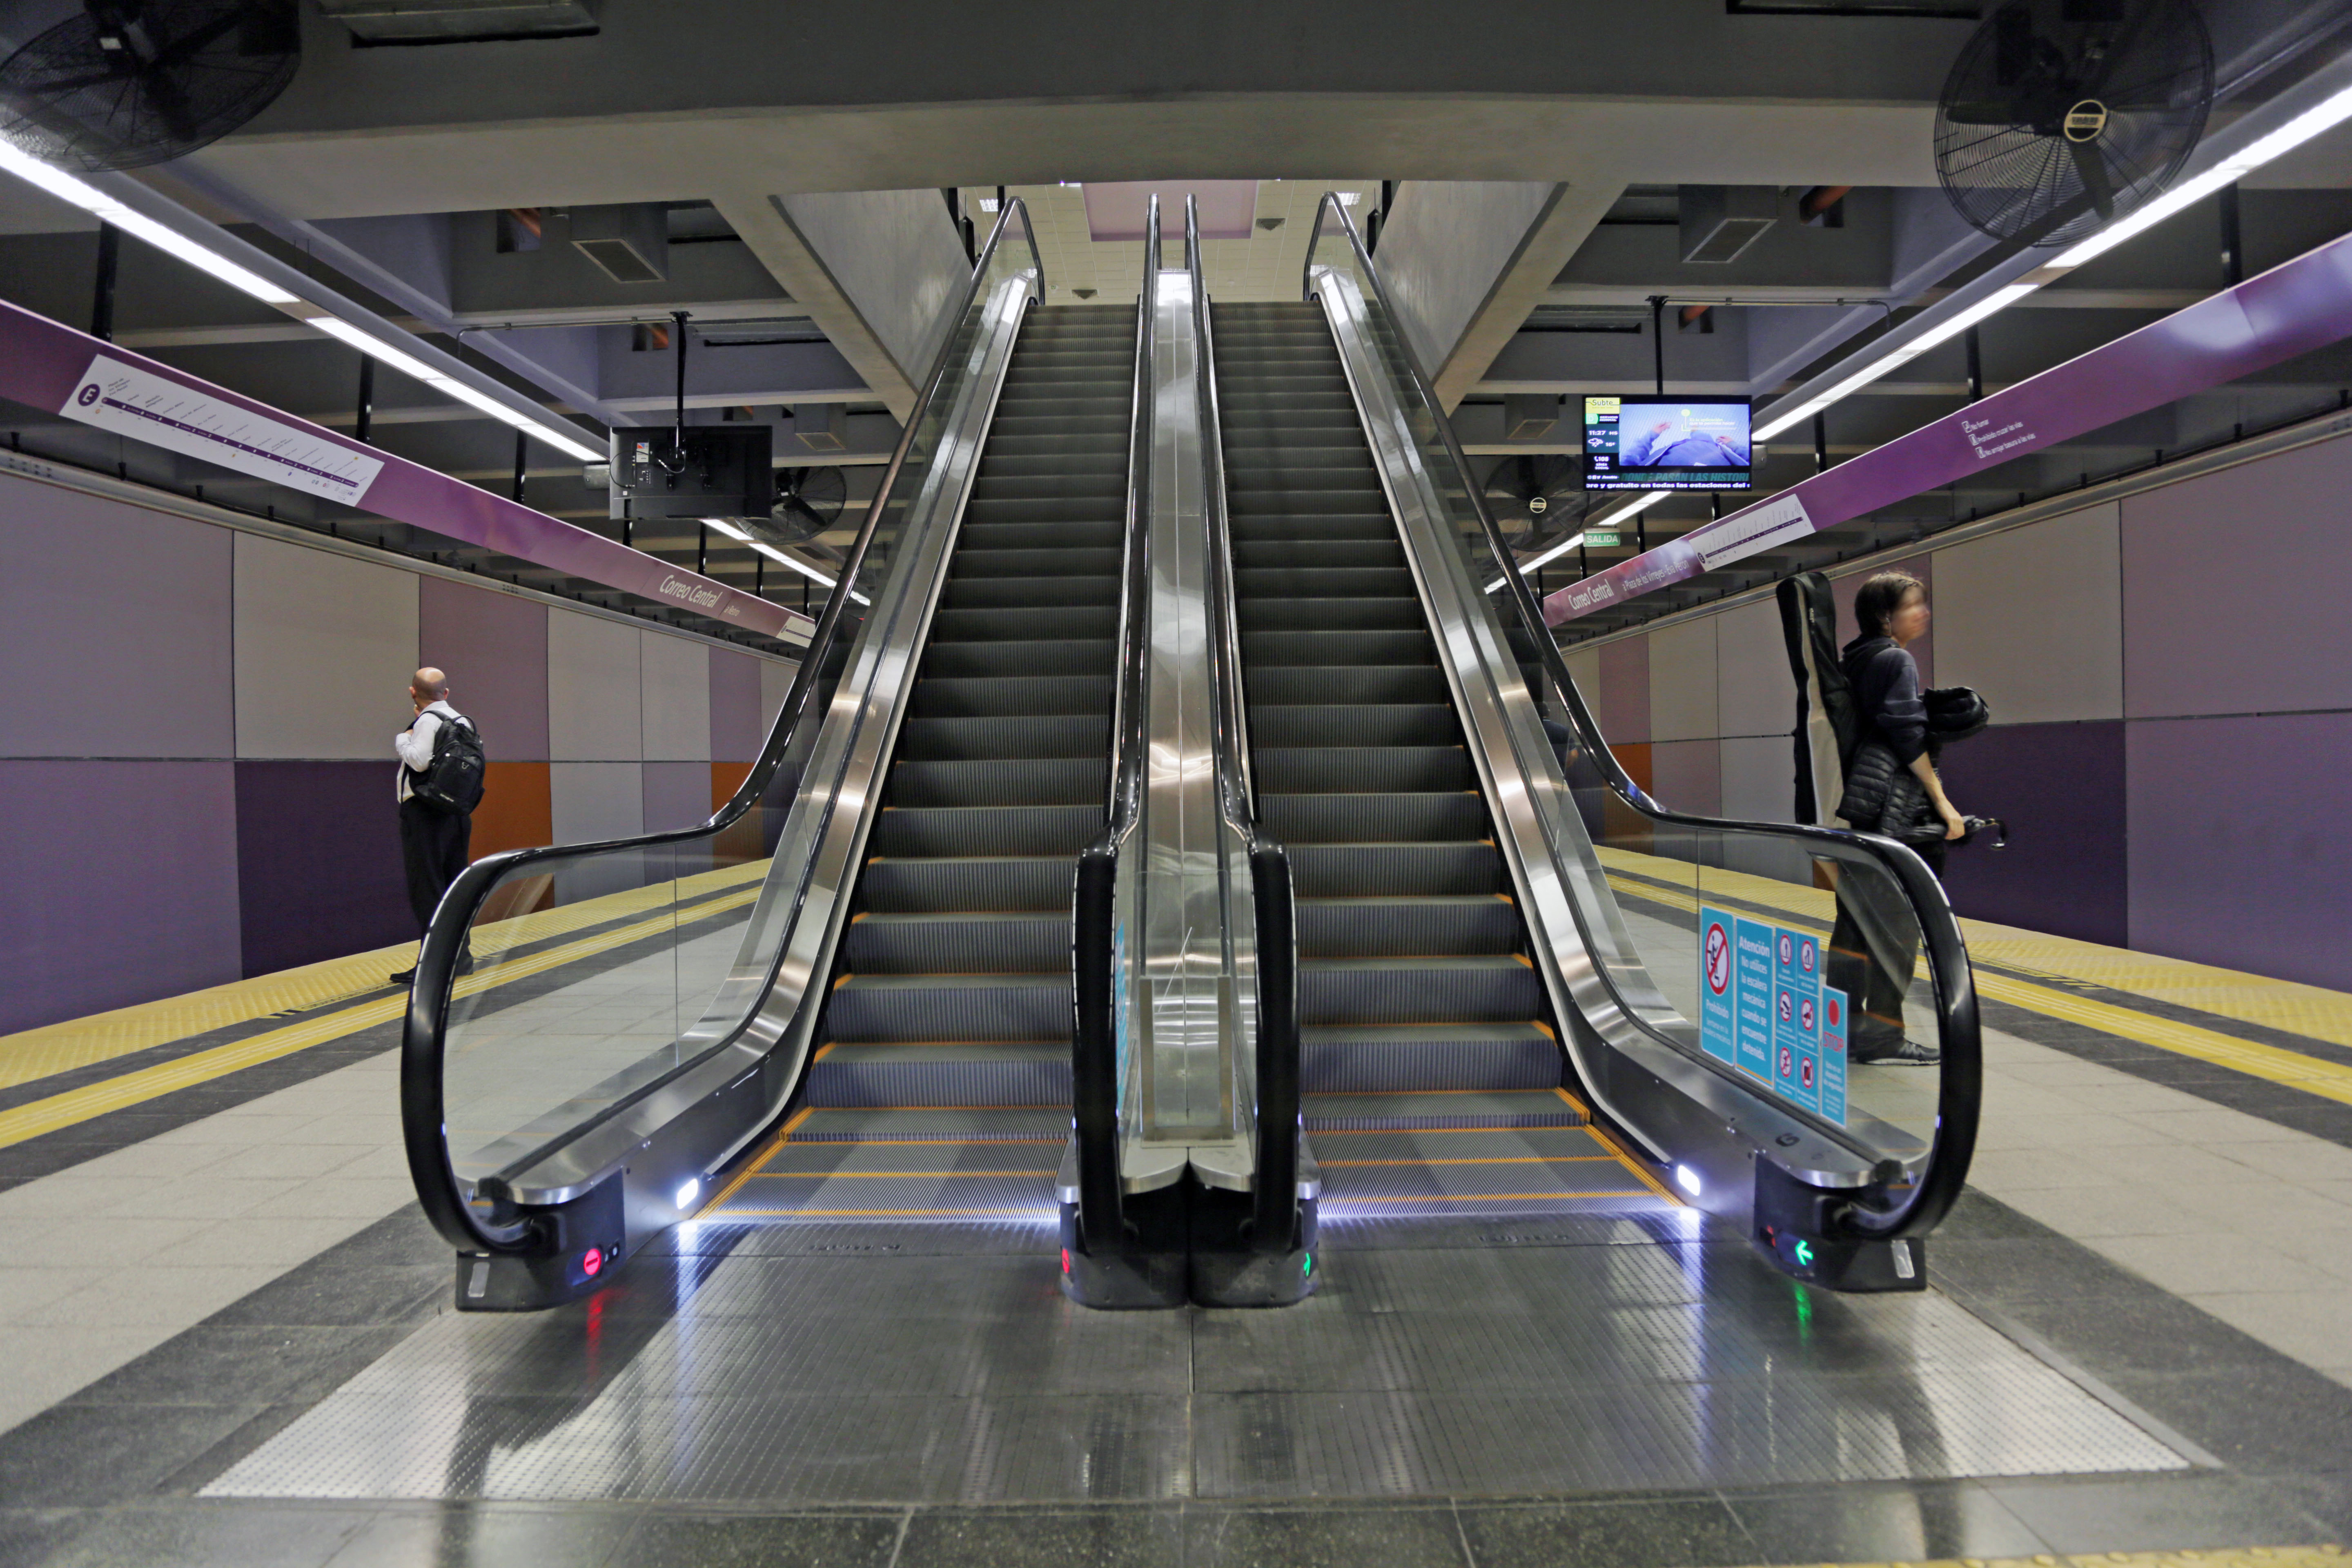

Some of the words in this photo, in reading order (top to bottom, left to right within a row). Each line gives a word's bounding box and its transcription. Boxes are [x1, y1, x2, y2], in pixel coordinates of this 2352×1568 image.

[82, 388, 97, 403] E
[1655, 473, 1688, 481] PASAN
[1689, 473, 1709, 481] LAS
[1587, 535, 1618, 543] SALIDA
[1624, 580, 1637, 591] Plaza
[1636, 577, 1642, 585] de
[1646, 570, 1664, 581] Virreyes
[1665, 564, 1676, 576] Eva
[1674, 559, 1690, 573] Perón
[659, 575, 691, 599] Correo
[688, 585, 723, 608] Central
[1568, 594, 1590, 610] Correo
[1587, 578, 1614, 603] Central
[1739, 935, 1770, 958] Atención
[1741, 955, 1749, 968] No
[1749, 959, 1768, 975] utilices
[1741, 971, 1746, 984] la
[1747, 977, 1768, 992] escalera
[1706, 998, 1729, 1019] Prohibido
[1742, 991, 1766, 1009] mecánica
[1742, 1008, 1760, 1024] cuando
[1760, 1016, 1767, 1027] se
[1741, 1025, 1767, 1045] encuentre
[1824, 1031, 1844, 1053] STOP
